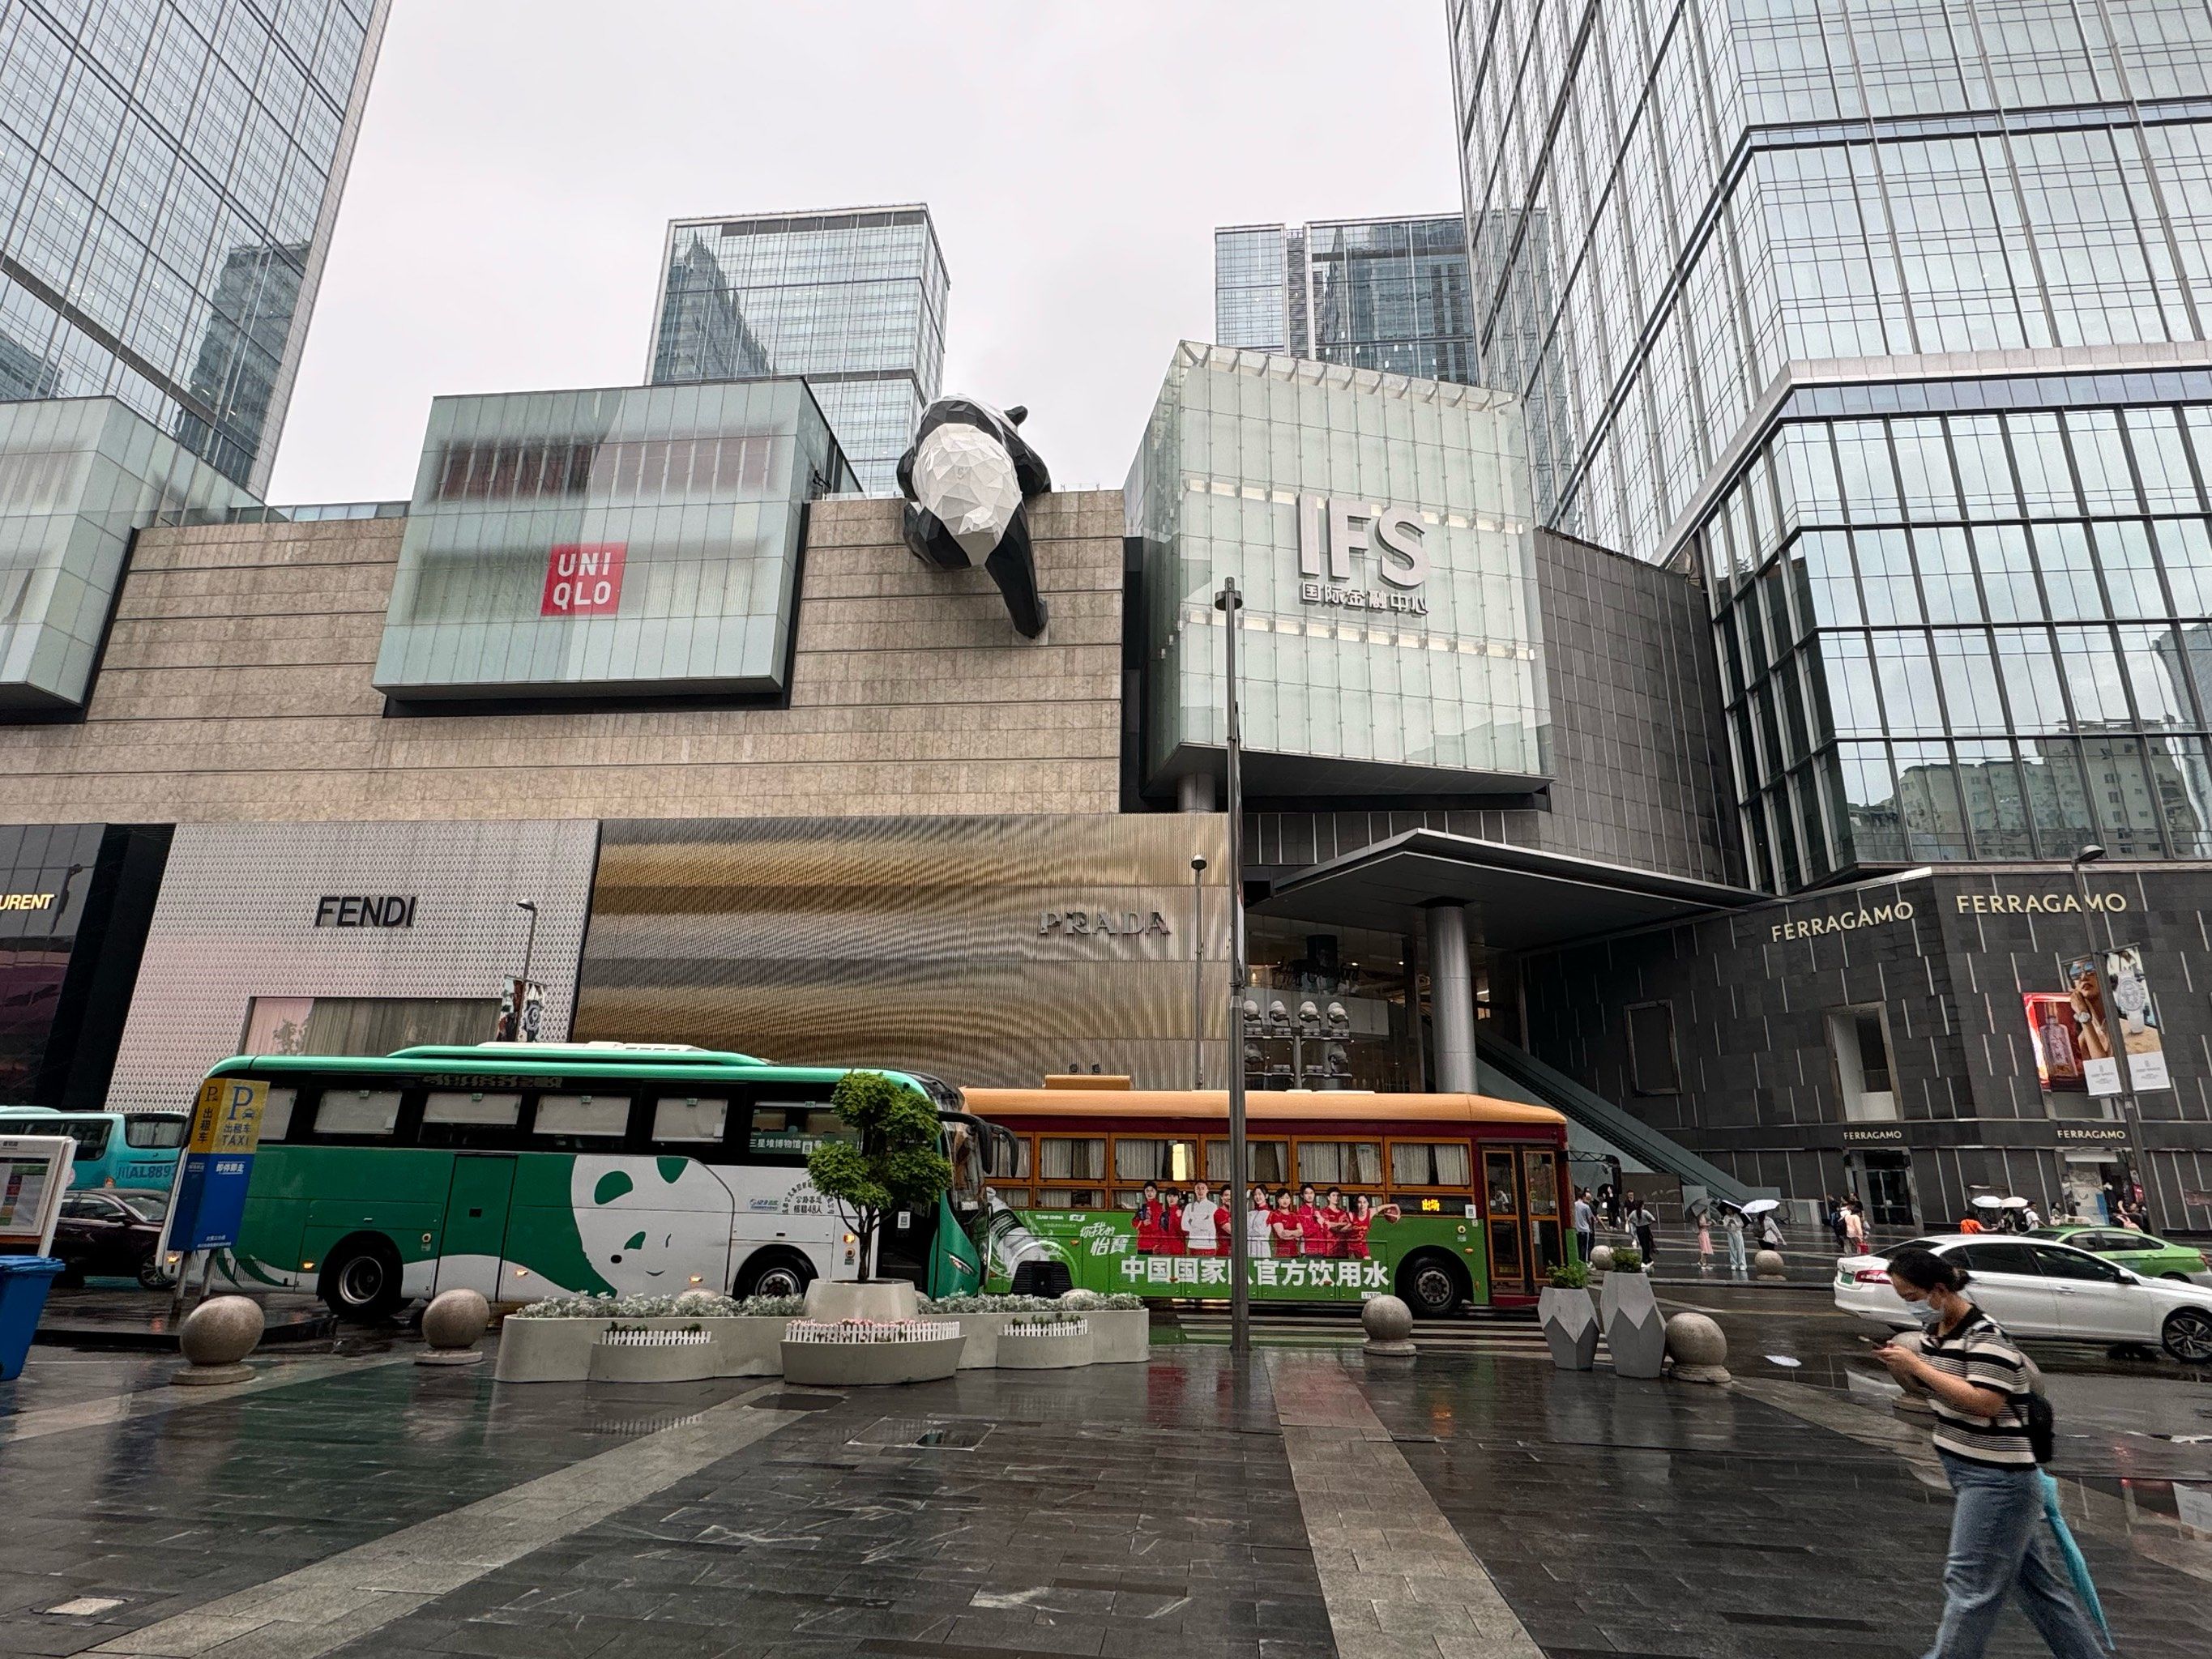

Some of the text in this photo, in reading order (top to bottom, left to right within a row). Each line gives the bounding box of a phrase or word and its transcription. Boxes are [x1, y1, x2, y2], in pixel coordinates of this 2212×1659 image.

[1298, 493, 1431, 587] IFS
[557, 552, 612, 577] UNI
[553, 581, 611, 610] QLO
[1301, 581, 1429, 615] 国际金融中心
[0, 893, 55, 911] URENT
[314, 896, 416, 927] FENDI
[1955, 893, 2128, 914] FERRAGAMO
[1040, 911, 1172, 935] PRADA
[1771, 902, 1914, 943] FERRAGAMO
[227, 1085, 254, 1120] P
[197, 1107, 214, 1144] 出租车
[223, 1122, 253, 1134] 出租车
[1843, 1130, 1902, 1141] FERRAGAMO
[2056, 1129, 2126, 1139] FERRAGAMO
[222, 1134, 250, 1146] TAXI
[749, 1138, 801, 1149] 三星堆博物馆
[1079, 1221, 1116, 1239] 你我的
